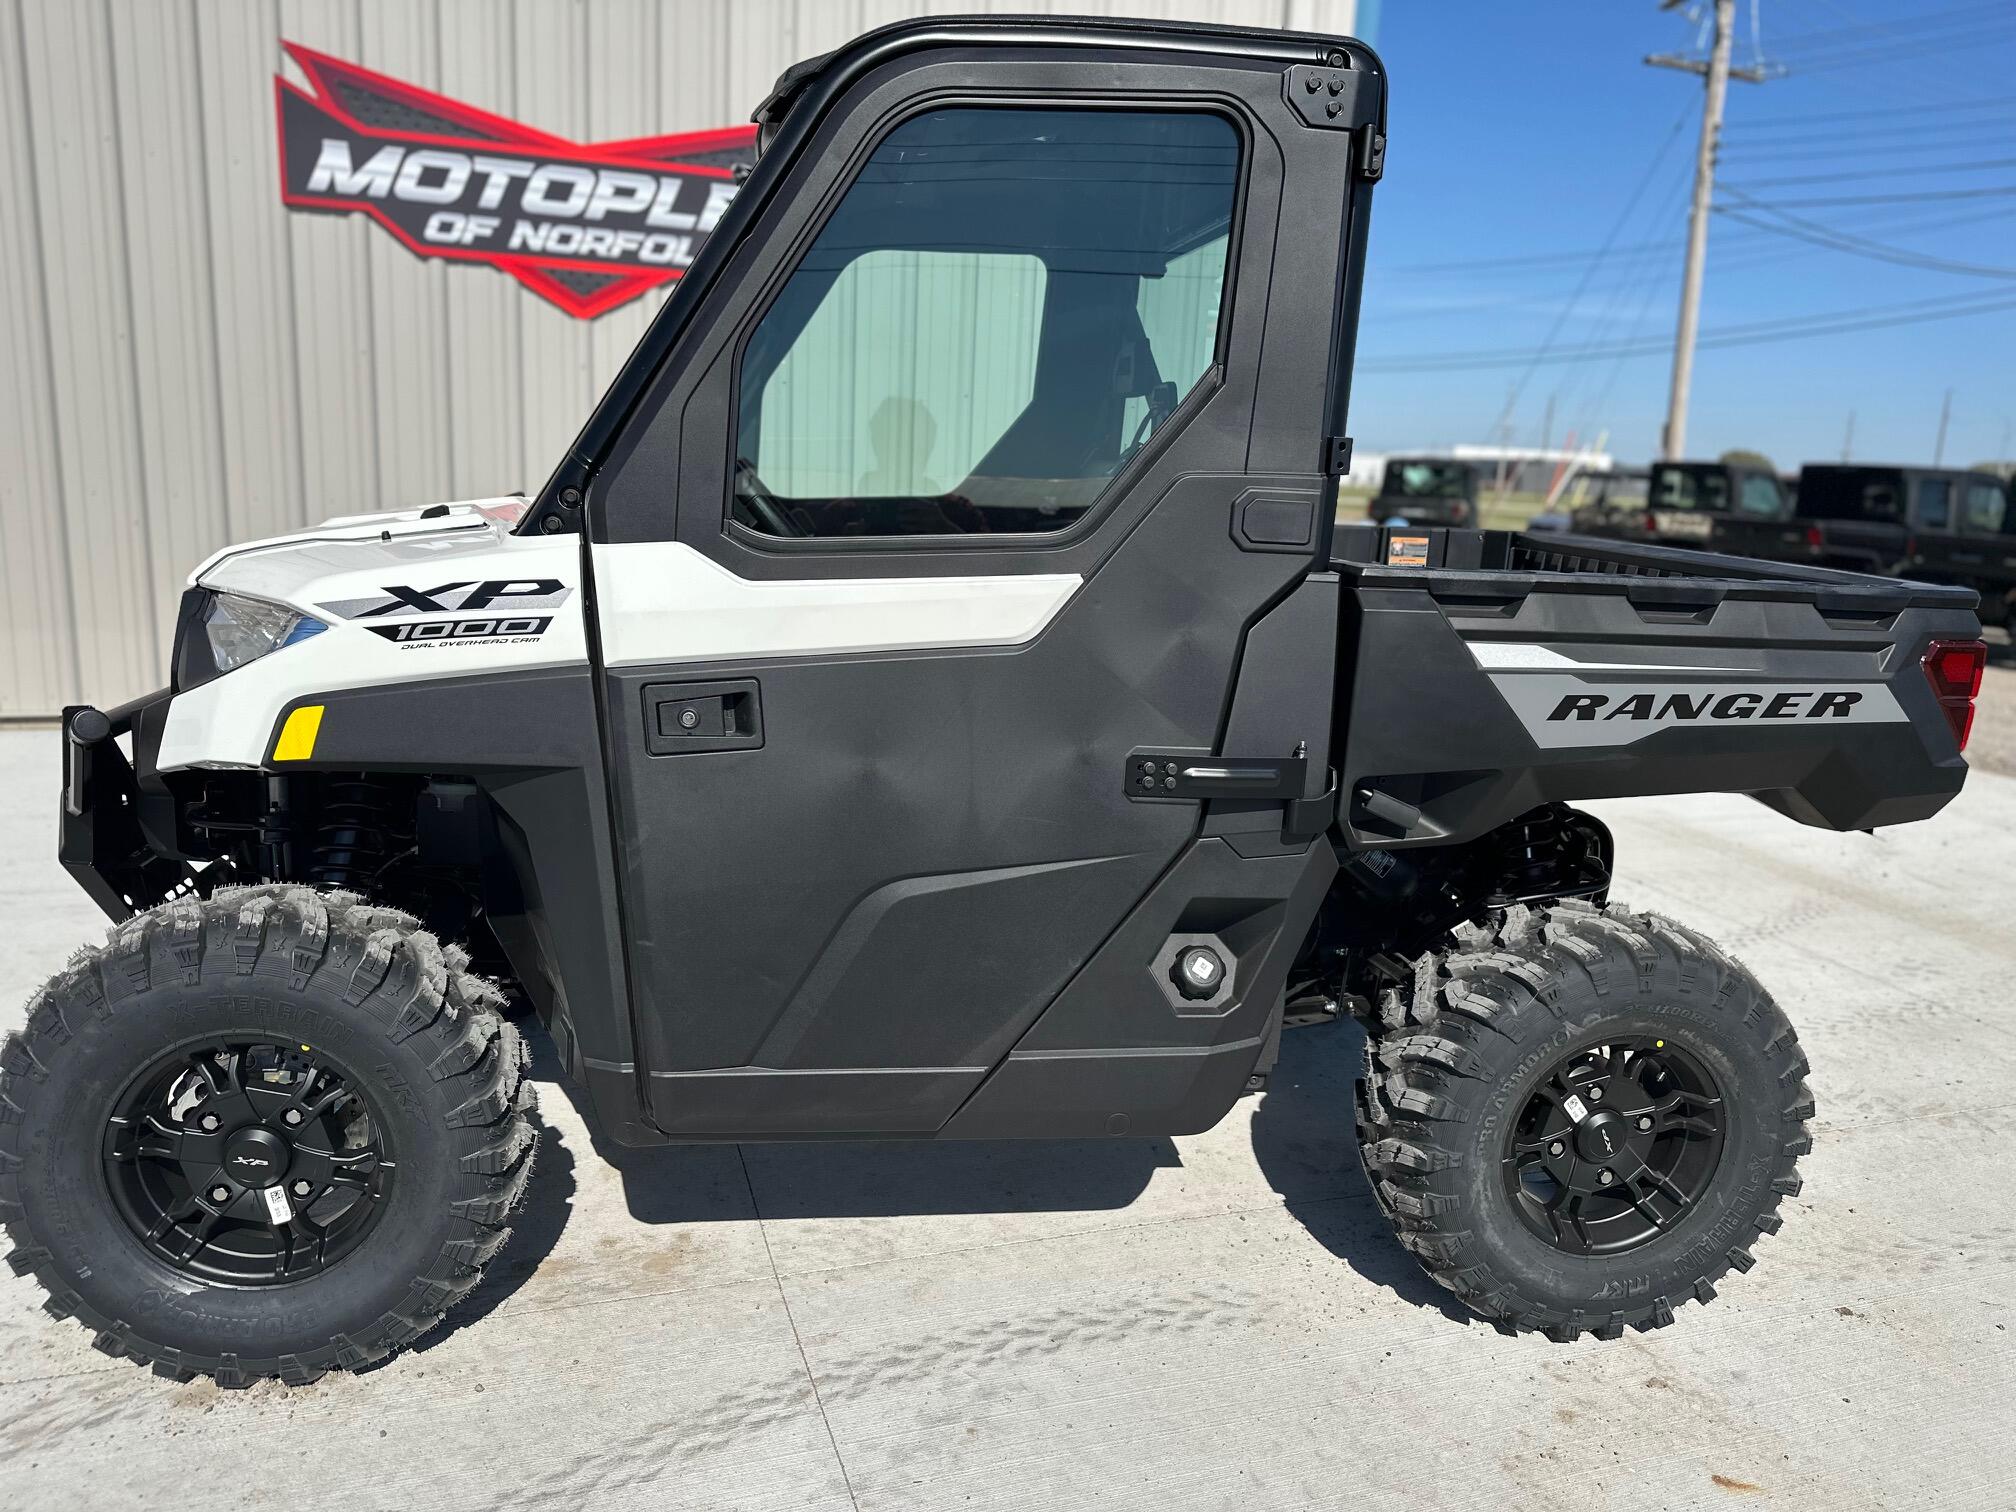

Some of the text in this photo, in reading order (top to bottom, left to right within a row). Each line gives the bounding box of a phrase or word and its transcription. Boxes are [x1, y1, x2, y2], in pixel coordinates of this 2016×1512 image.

[308, 139, 740, 232] MOTOPLE
[423, 211, 694, 267] OF NORFOL
[352, 578, 566, 618] XP
[396, 618, 541, 640] 1000
[438, 638, 509, 647] OVERHEAD
[1545, 690, 1864, 722] RANGER
[167, 992, 354, 1045] X-TERRAIN
[1474, 1041, 1553, 1158] PRO ARMOR
[1601, 1128, 1614, 1154] XP
[232, 1156, 270, 1167] XP
[1673, 1153, 1775, 1276] X-TERRAIN
